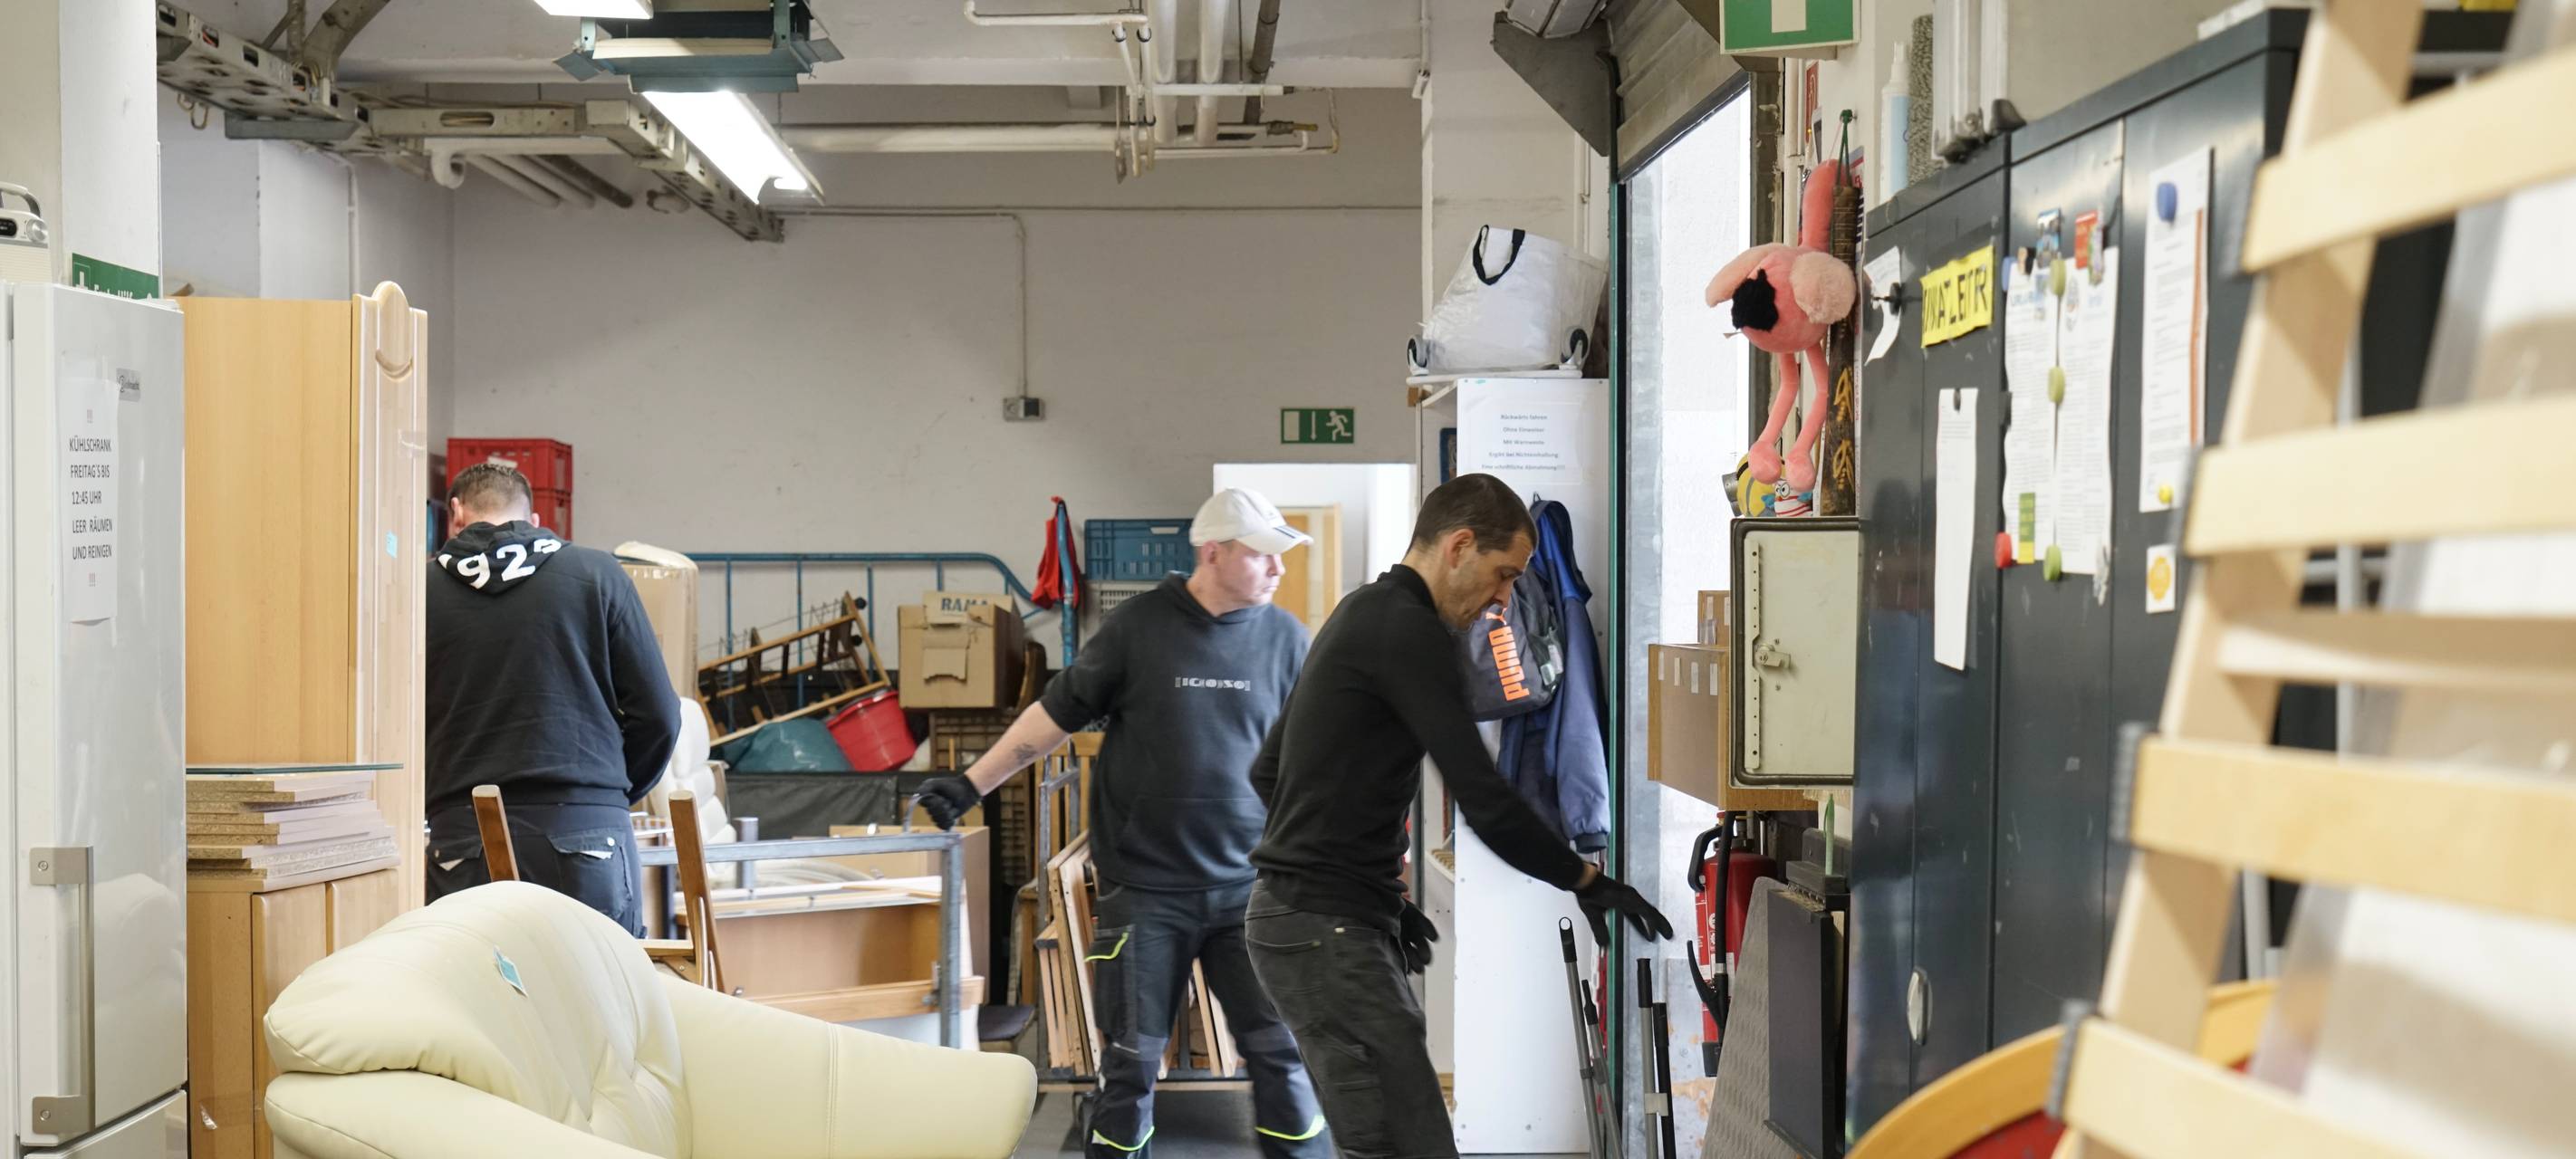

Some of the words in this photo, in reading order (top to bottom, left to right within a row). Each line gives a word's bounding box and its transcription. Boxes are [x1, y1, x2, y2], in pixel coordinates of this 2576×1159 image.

[69, 435, 111, 452] KÜHLSCHRANK
[101, 465, 111, 478] BIS
[72, 491, 88, 504] 12:45
[89, 491, 101, 504] UHR
[72, 519, 87, 533] LEER
[89, 516, 112, 532] RÄUMEN
[72, 546, 87, 560] UND
[88, 544, 112, 558] REINIGEN
